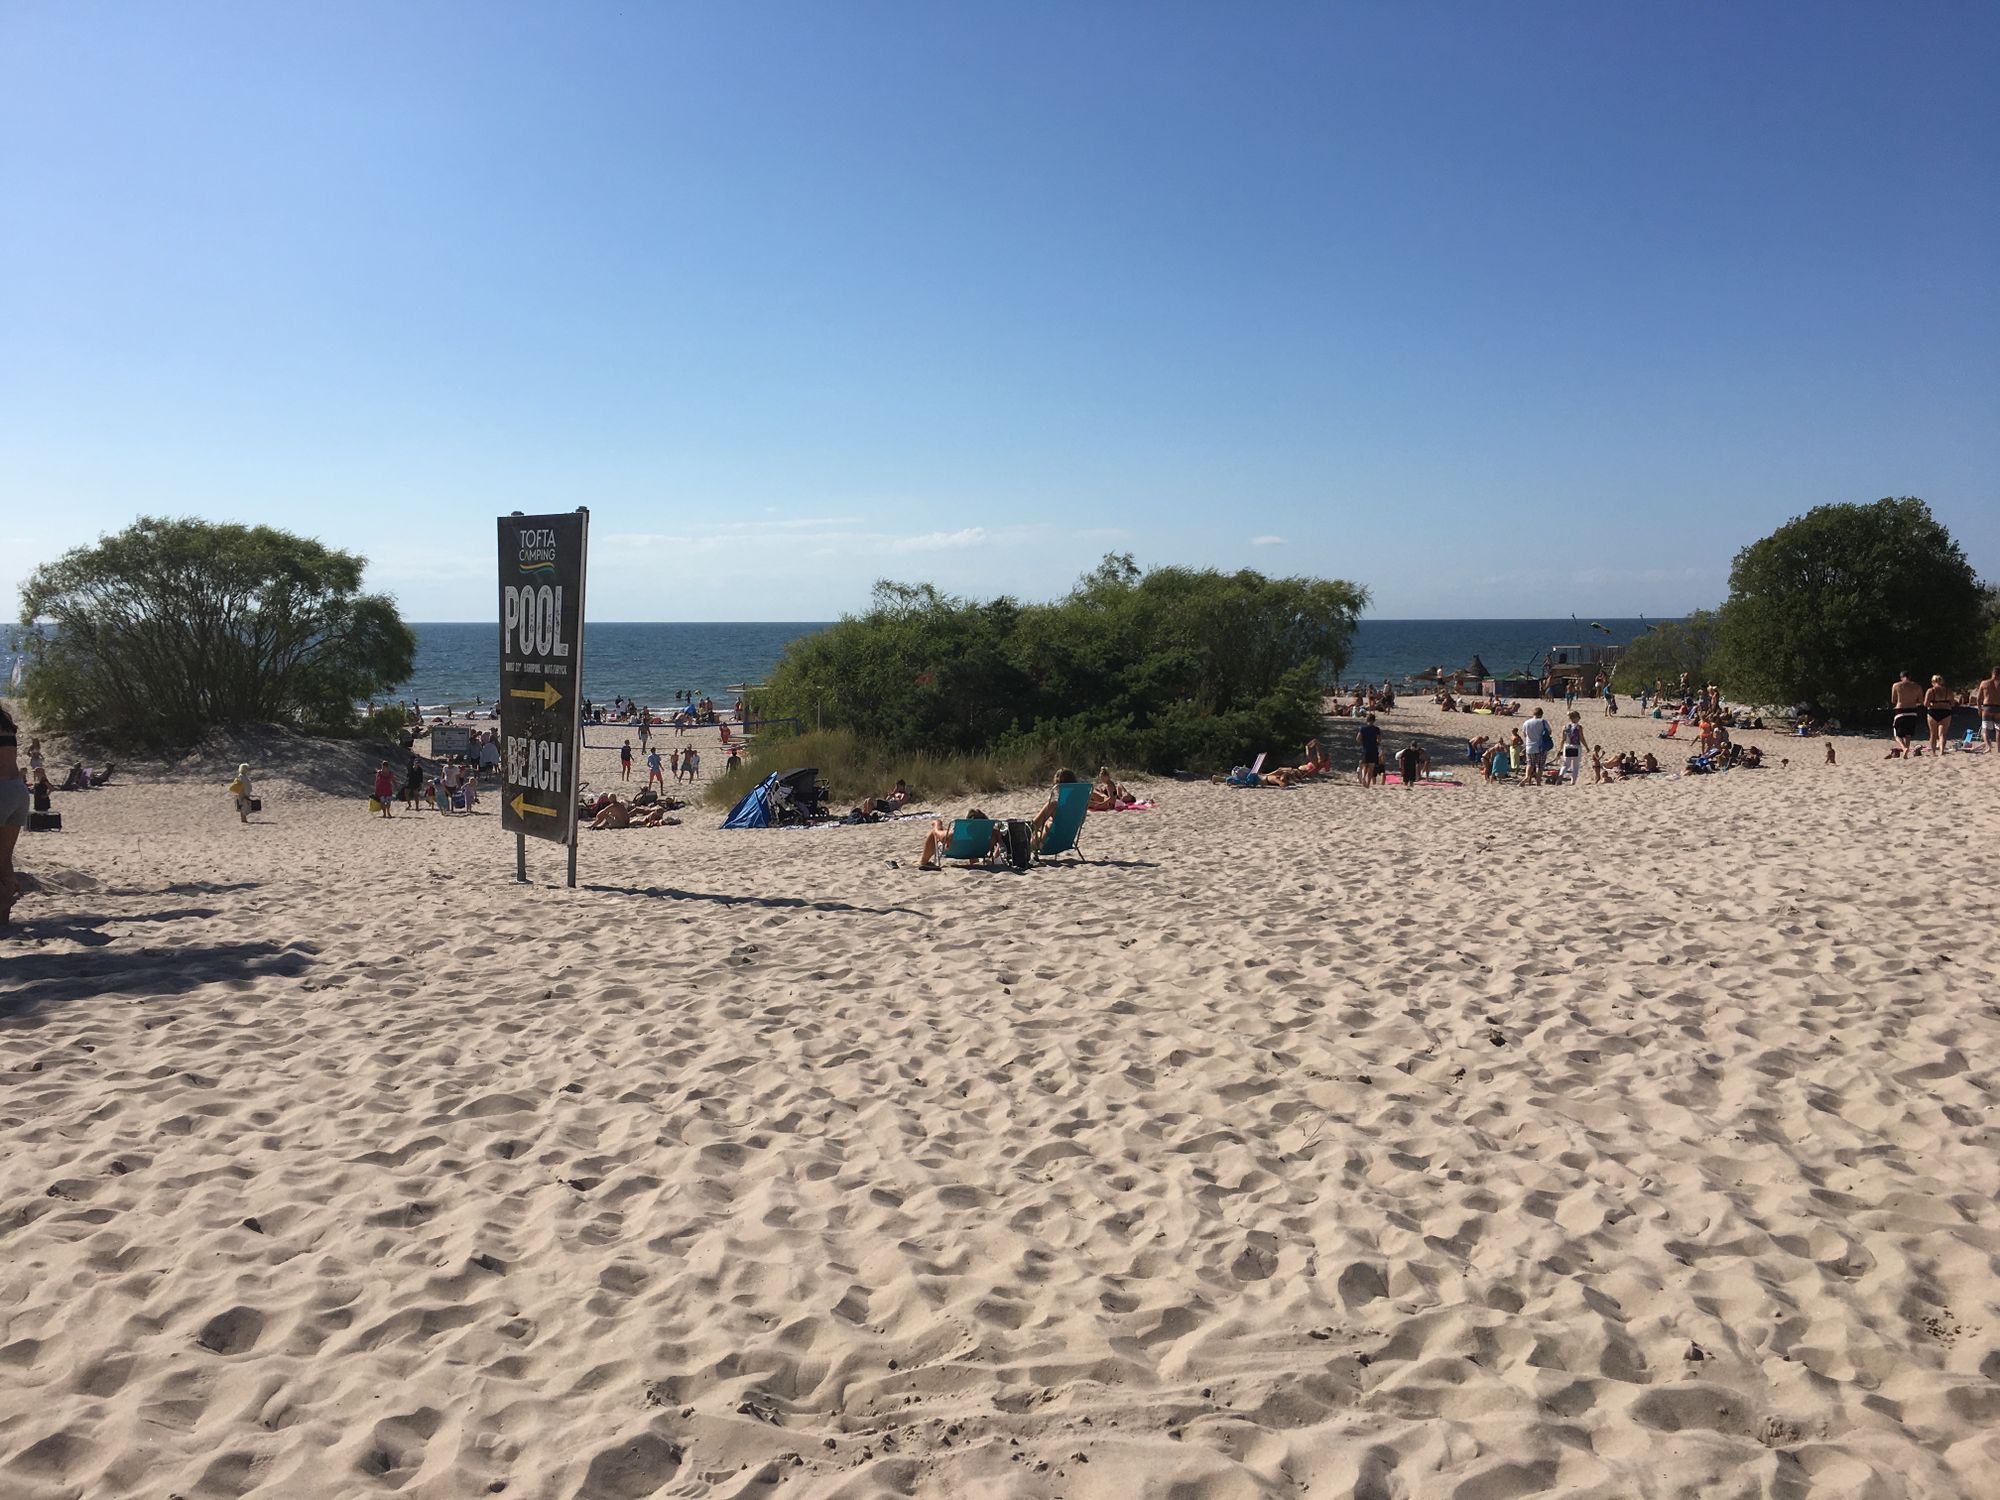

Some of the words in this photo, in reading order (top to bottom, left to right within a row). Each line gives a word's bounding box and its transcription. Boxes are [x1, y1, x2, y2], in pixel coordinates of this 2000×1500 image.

[519, 548, 556, 561] CAMPING
[520, 529, 556, 548] TOFTA
[504, 585, 568, 657] POOL
[507, 735, 563, 793] BEACH
